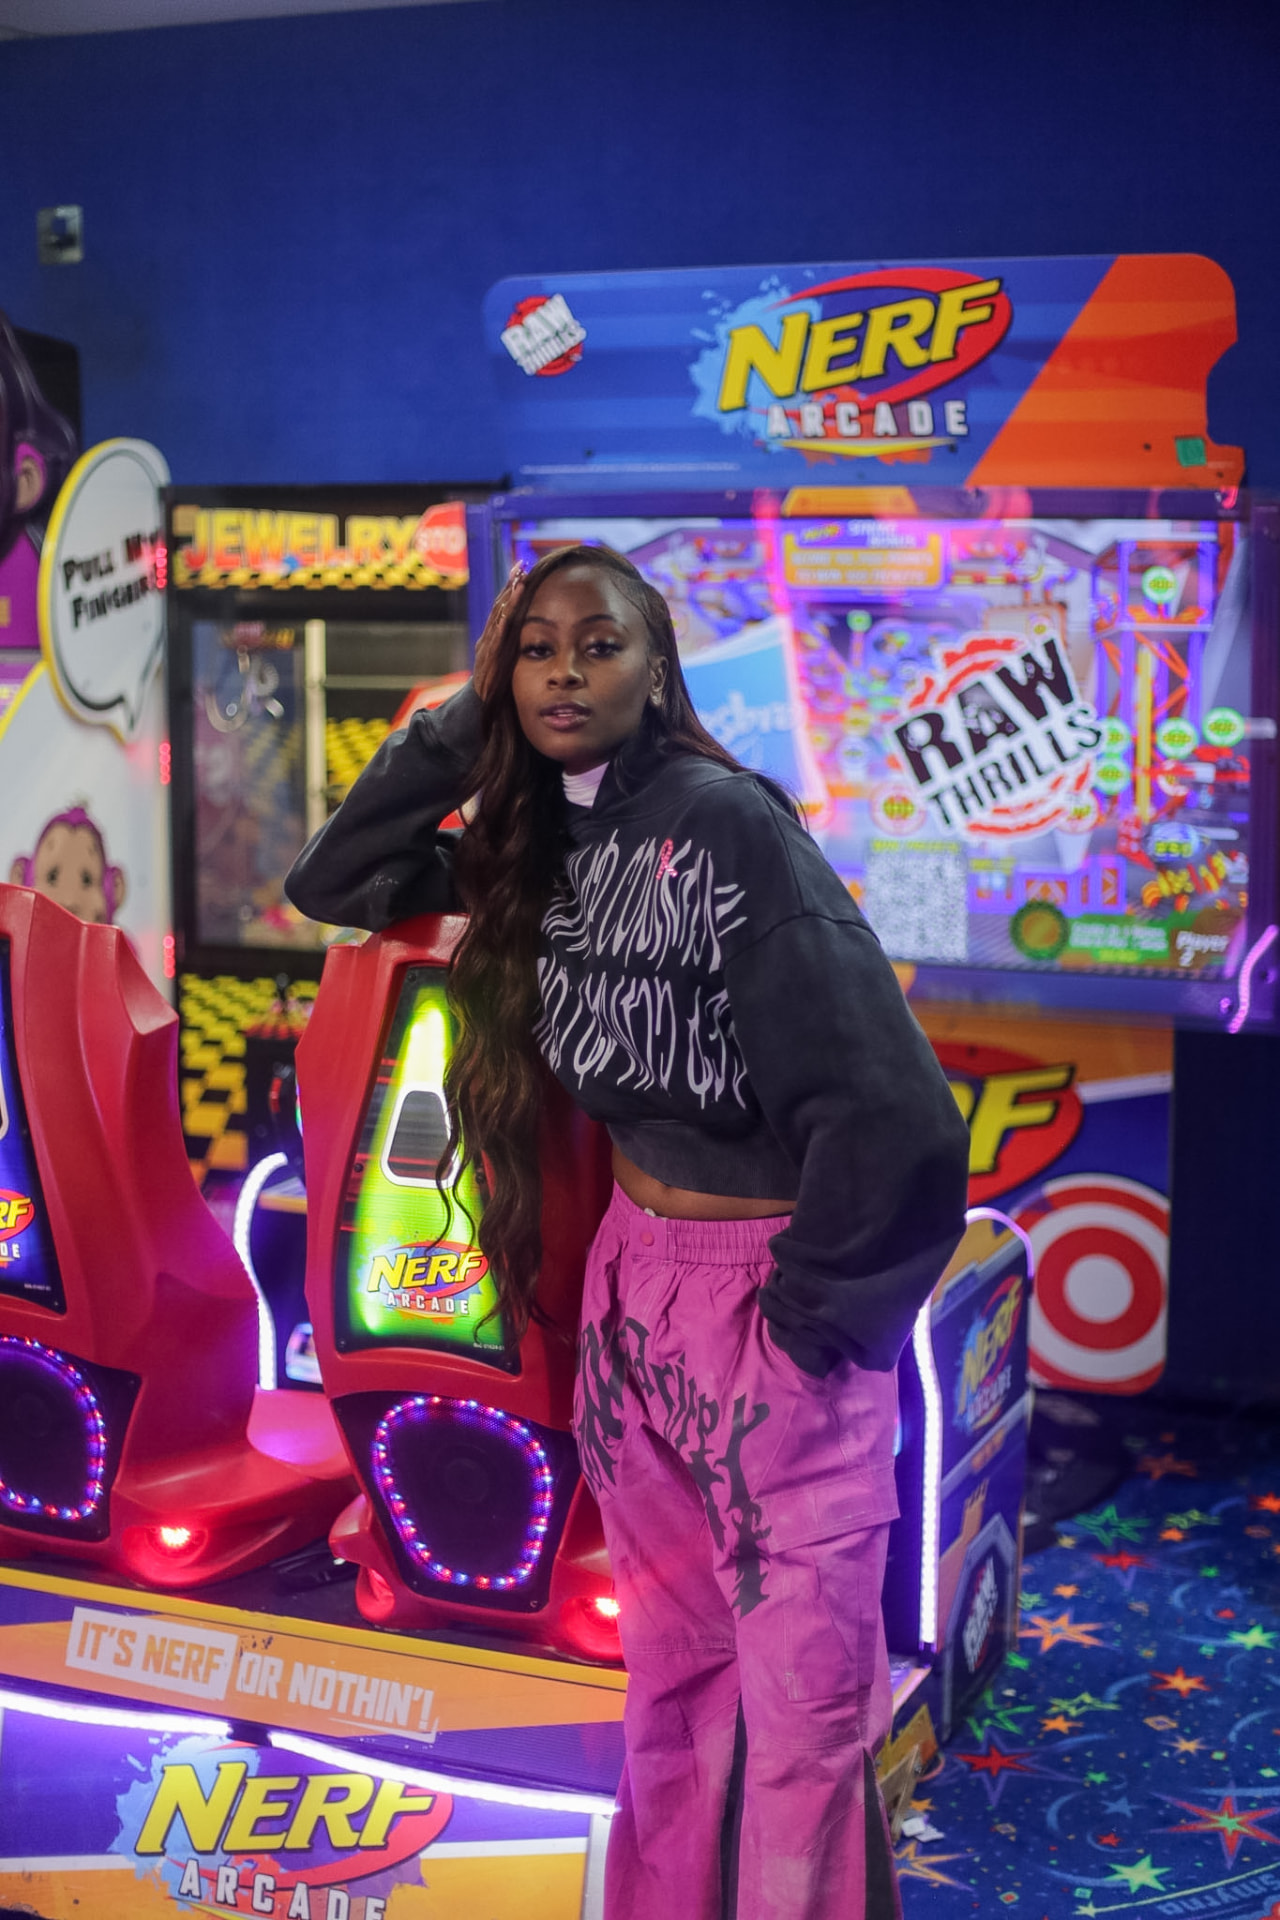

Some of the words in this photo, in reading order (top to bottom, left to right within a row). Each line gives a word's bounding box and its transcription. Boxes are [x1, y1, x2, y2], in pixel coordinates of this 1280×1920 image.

[717, 278, 1002, 414] NERF
[767, 400, 969, 438] ARCADE
[182, 508, 424, 572] JEWELRY
[895, 638, 1074, 785] RAW
[928, 708, 1103, 826] THRILLS
[367, 1250, 484, 1292] NERF
[387, 1291, 470, 1315] ARCADE
[76, 1620, 137, 1668] IT'S
[142, 1634, 225, 1685] NERF
[236, 1651, 284, 1699] OR
[288, 1661, 435, 1730] NOTHIN'!
[135, 1761, 434, 1853] NERF
[178, 1858, 387, 1920] ARCADE
